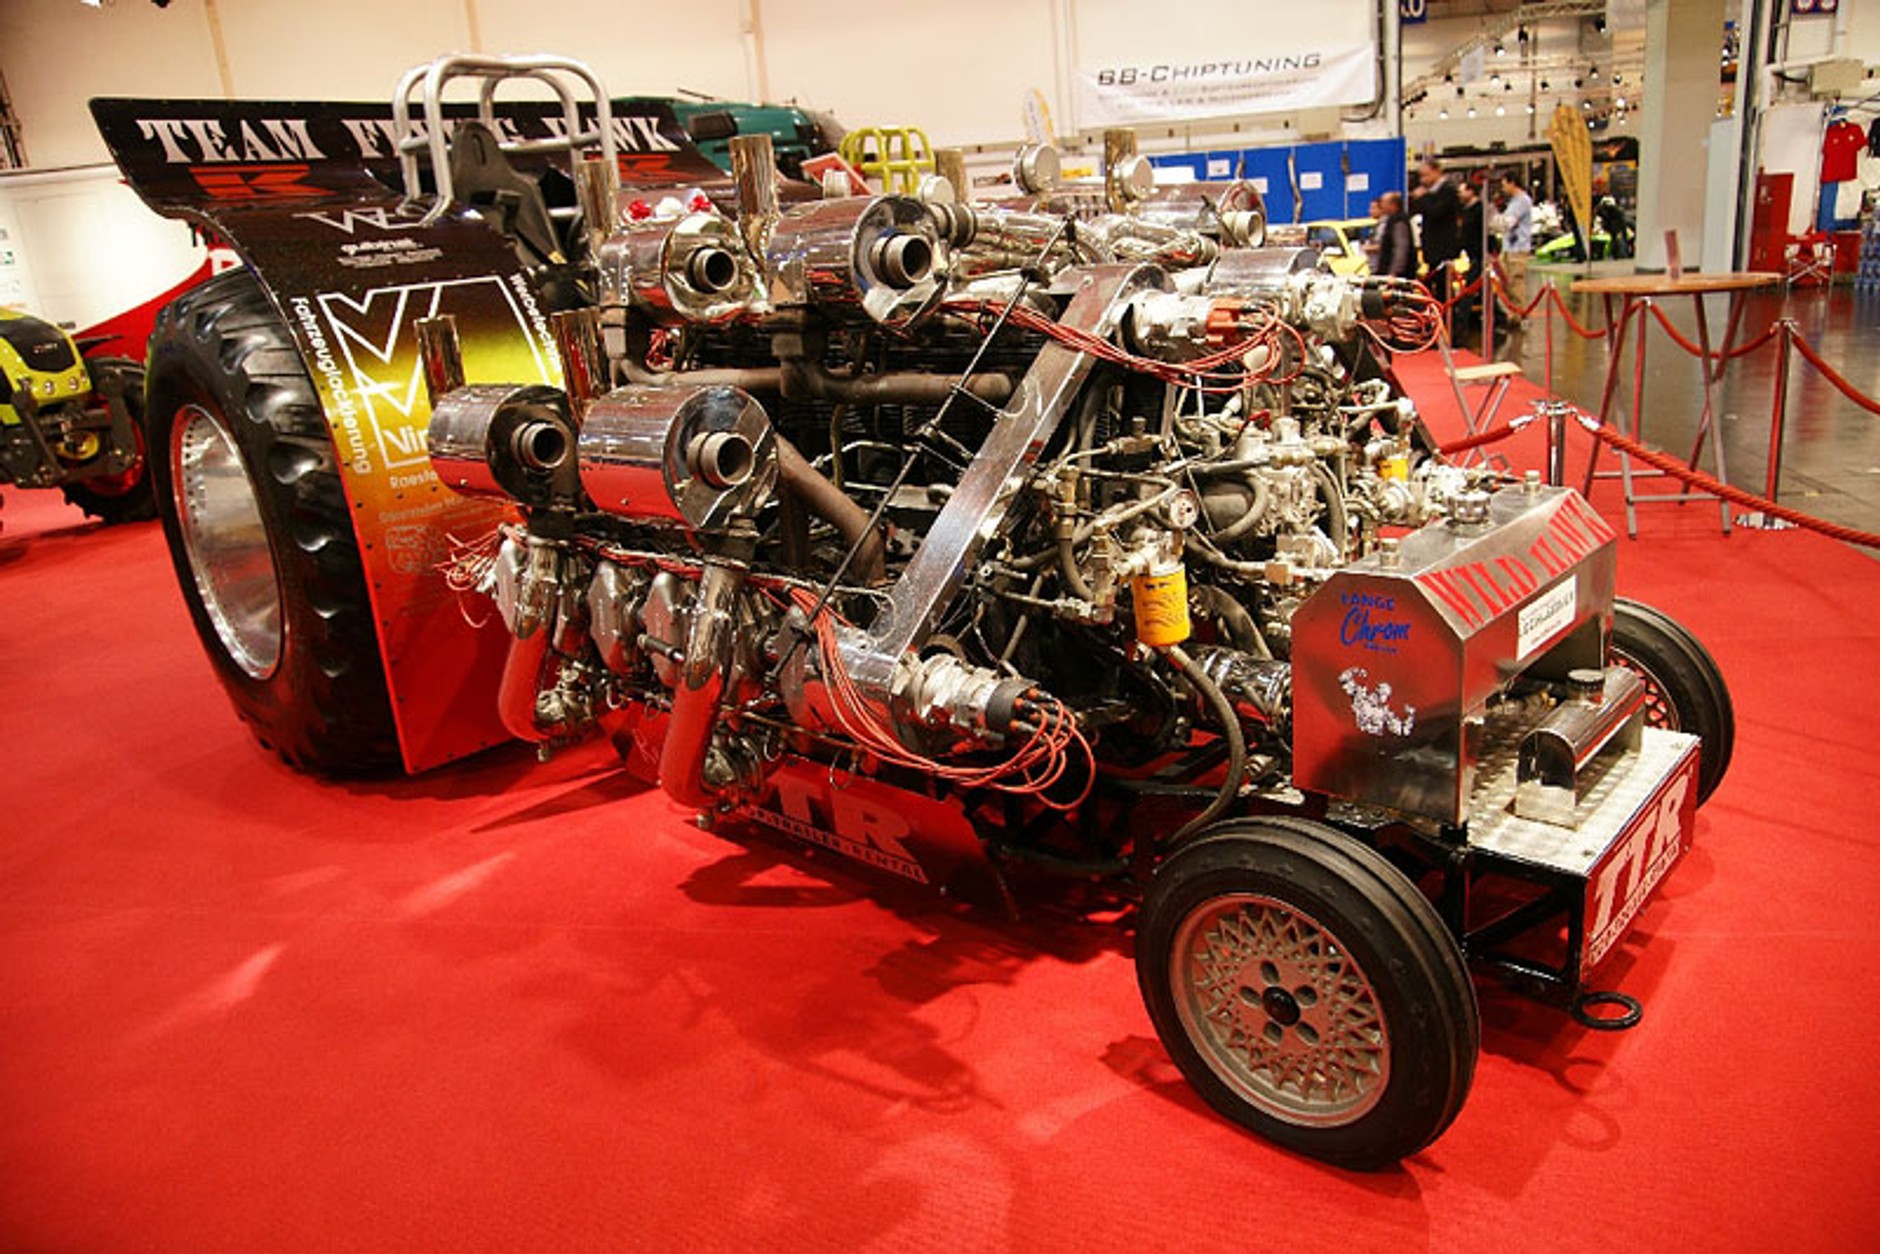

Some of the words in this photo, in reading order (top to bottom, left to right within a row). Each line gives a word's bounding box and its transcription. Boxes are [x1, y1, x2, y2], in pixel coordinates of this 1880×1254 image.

[135, 119, 328, 163] TEAM
[290, 297, 373, 474] Fahrzeuglackierung
[1414, 555, 1540, 630] WILD
[1529, 491, 1616, 577] HAWK
[1594, 772, 1689, 938] TTR
